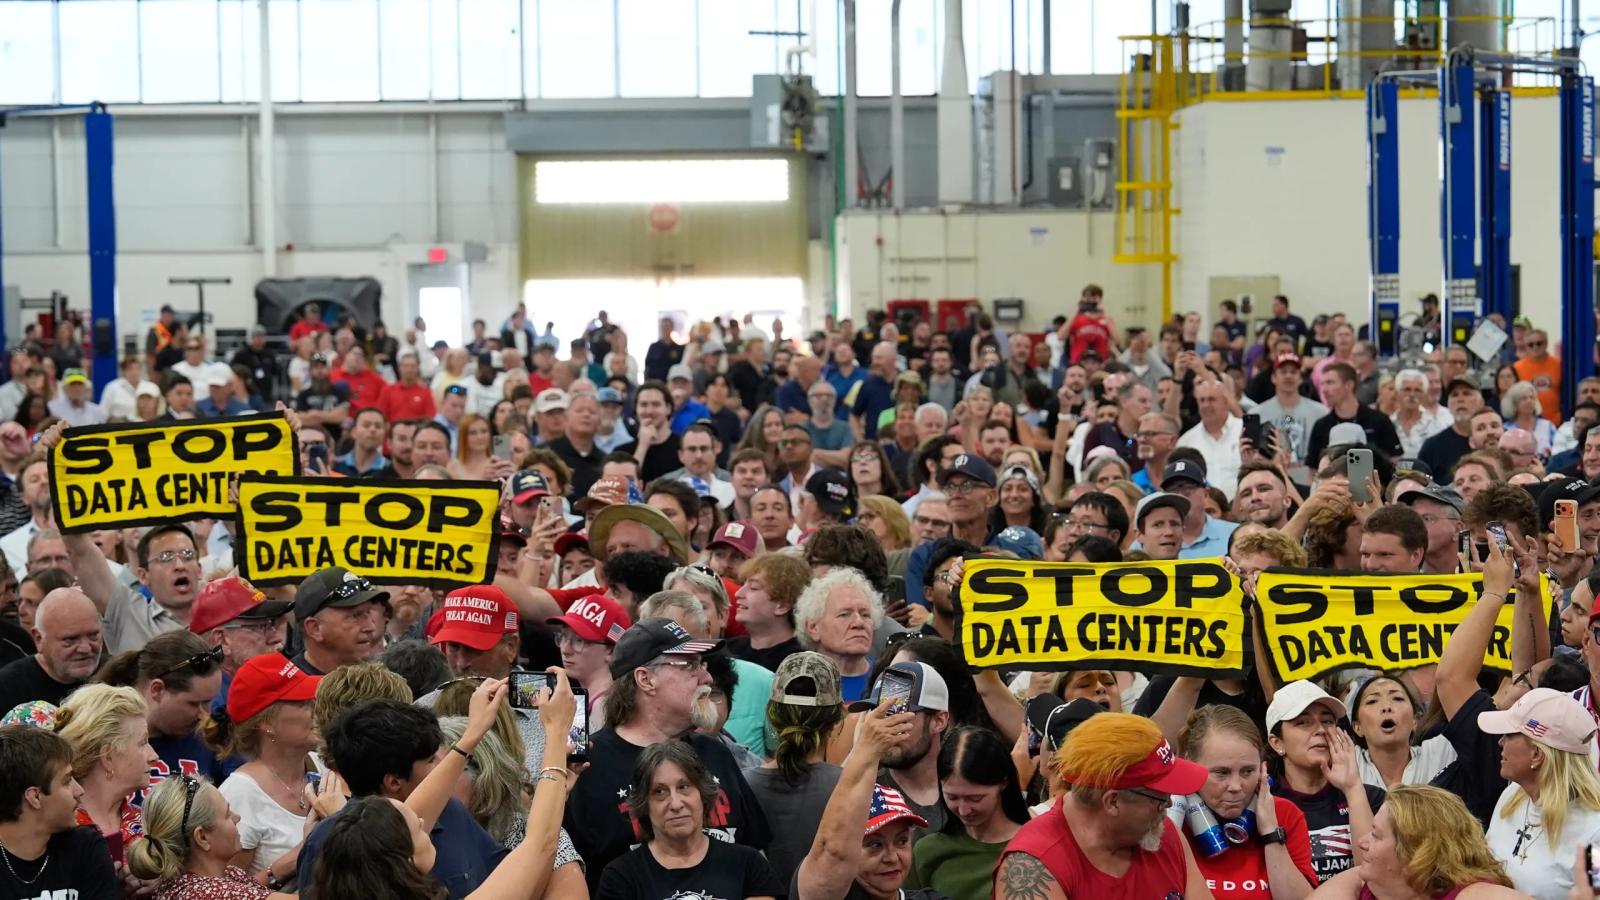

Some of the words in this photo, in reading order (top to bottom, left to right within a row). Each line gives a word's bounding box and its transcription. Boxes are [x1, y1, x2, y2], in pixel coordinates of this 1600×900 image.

[61, 423, 283, 475] STOP
[66, 477, 148, 519] DATA
[156, 470, 278, 507] CENT
[251, 491, 483, 533] STOP
[255, 536, 336, 573] DATA
[343, 535, 474, 575] CENTERS
[445, 597, 462, 608] MAKE
[461, 597, 499, 613] AMERICA
[969, 563, 1232, 613] STOP
[469, 611, 492, 625] AGAIN
[566, 599, 607, 628] MAGA
[972, 614, 1068, 658] DATA
[1077, 612, 1228, 660] CENTERS
[1279, 624, 1375, 672] DATA
[1380, 624, 1512, 661] CENR
[1206, 879, 1270, 891] EDOM
[1322, 858, 1354, 871] JAM
